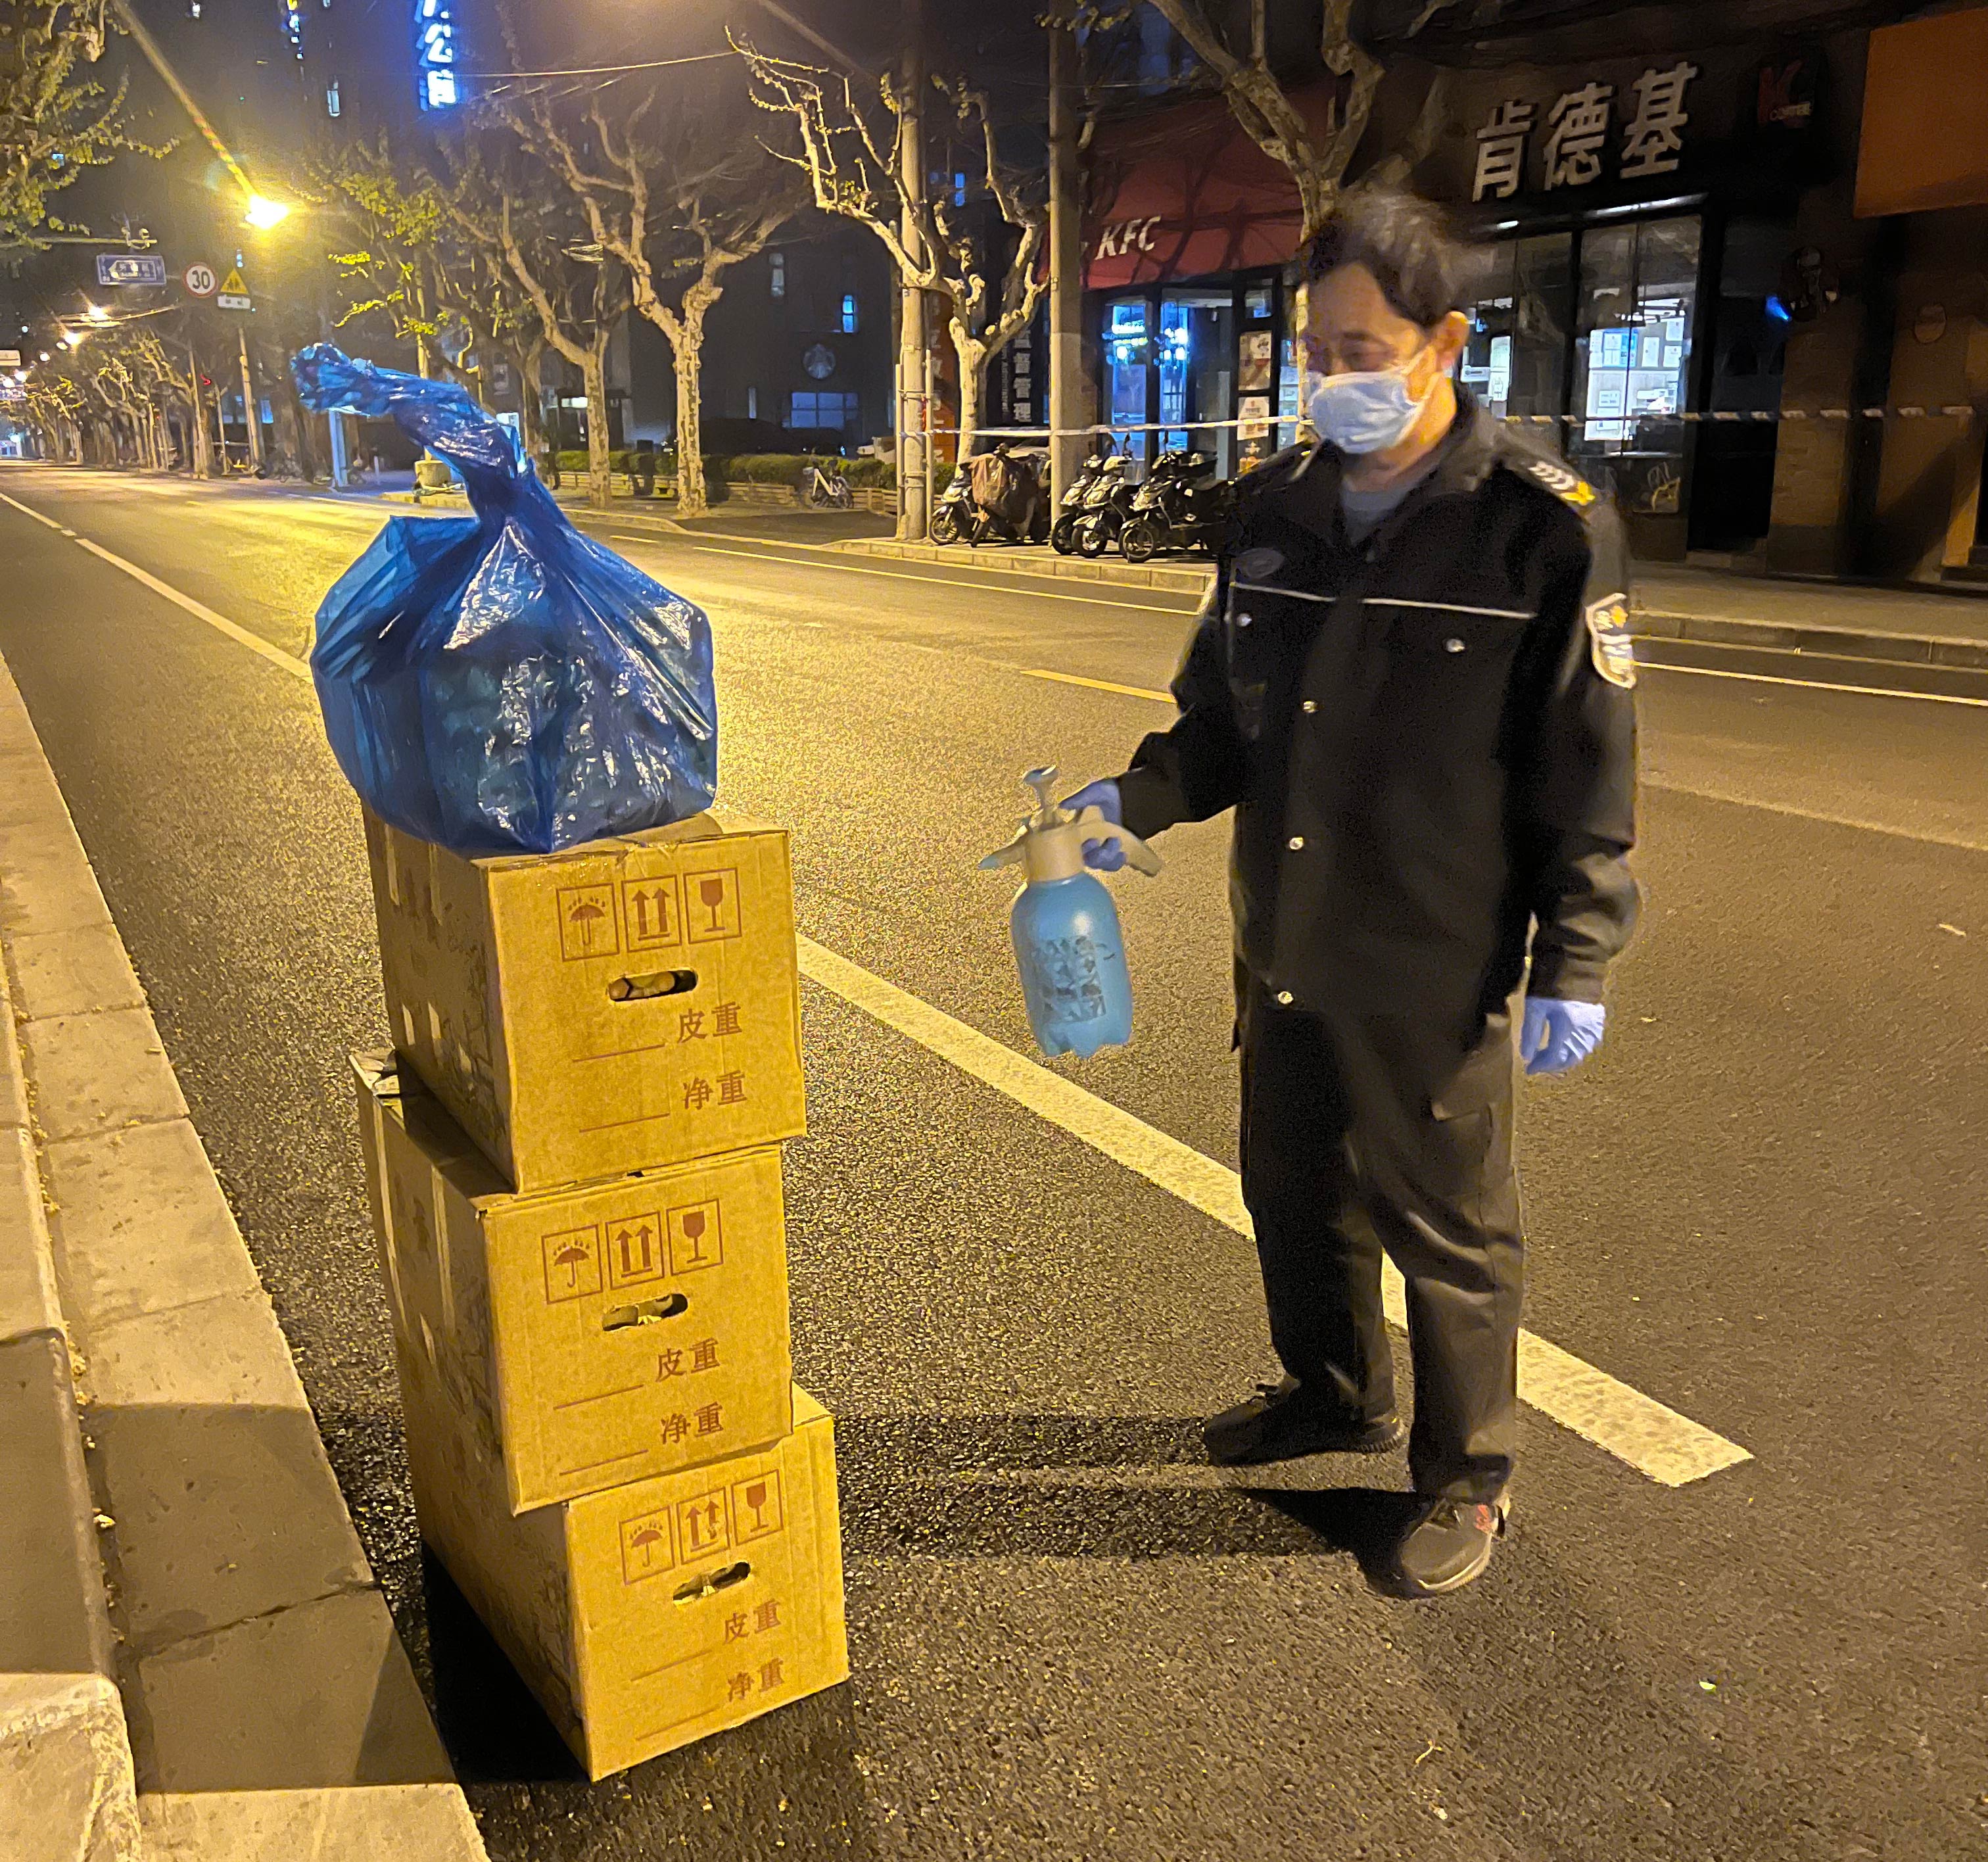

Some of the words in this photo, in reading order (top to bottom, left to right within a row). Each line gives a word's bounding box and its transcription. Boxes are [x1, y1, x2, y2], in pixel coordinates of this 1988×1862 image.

[1472, 61, 1699, 203] 肯德基
[1094, 215, 1162, 260] KFC
[191, 270, 211, 290] 30
[676, 1001, 743, 1044] 皮重
[682, 1070, 747, 1110] 净重
[655, 1337, 721, 1383] 皮重
[660, 1401, 724, 1444] 净重
[724, 1598, 782, 1644] 皮重
[727, 1658, 786, 1702] 净重
